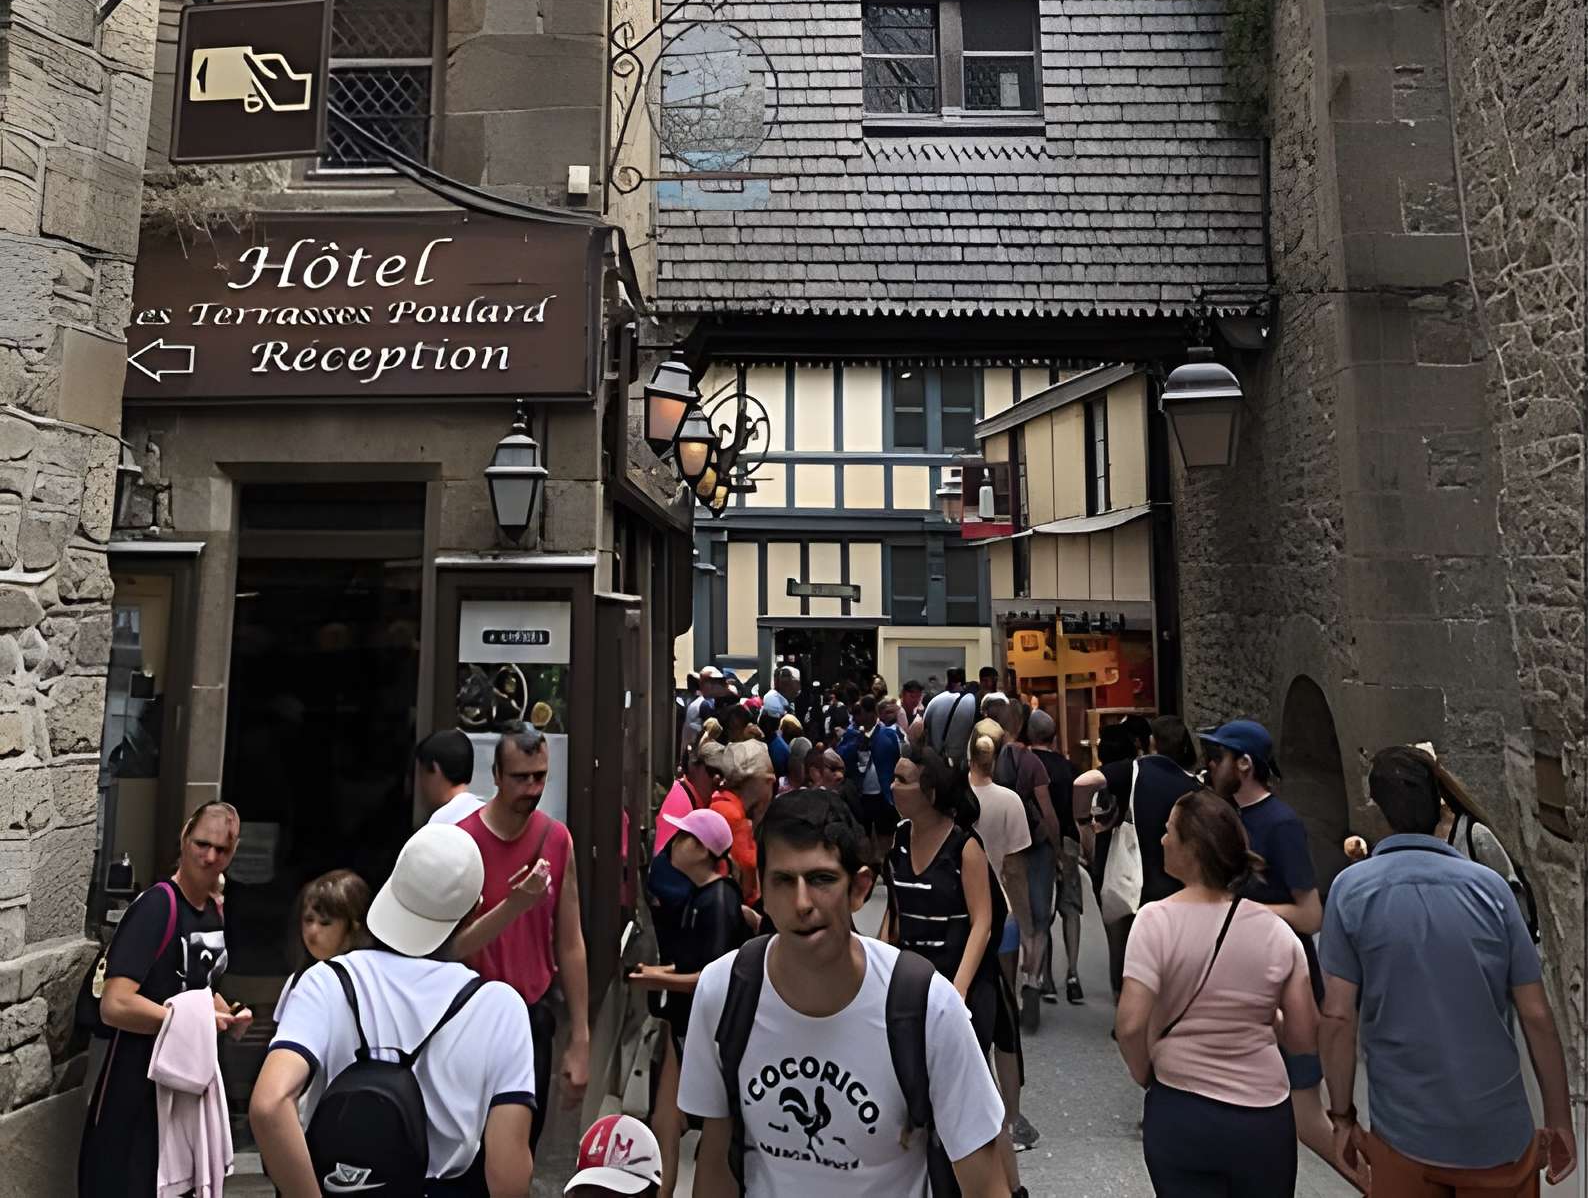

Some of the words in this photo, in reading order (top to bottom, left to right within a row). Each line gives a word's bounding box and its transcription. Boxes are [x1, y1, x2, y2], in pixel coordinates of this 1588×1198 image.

[228, 238, 453, 289] Hôtel
[136, 307, 172, 326] es
[188, 302, 374, 326] Terrasses
[388, 294, 558, 324] Poulard
[251, 338, 511, 384] Réception
